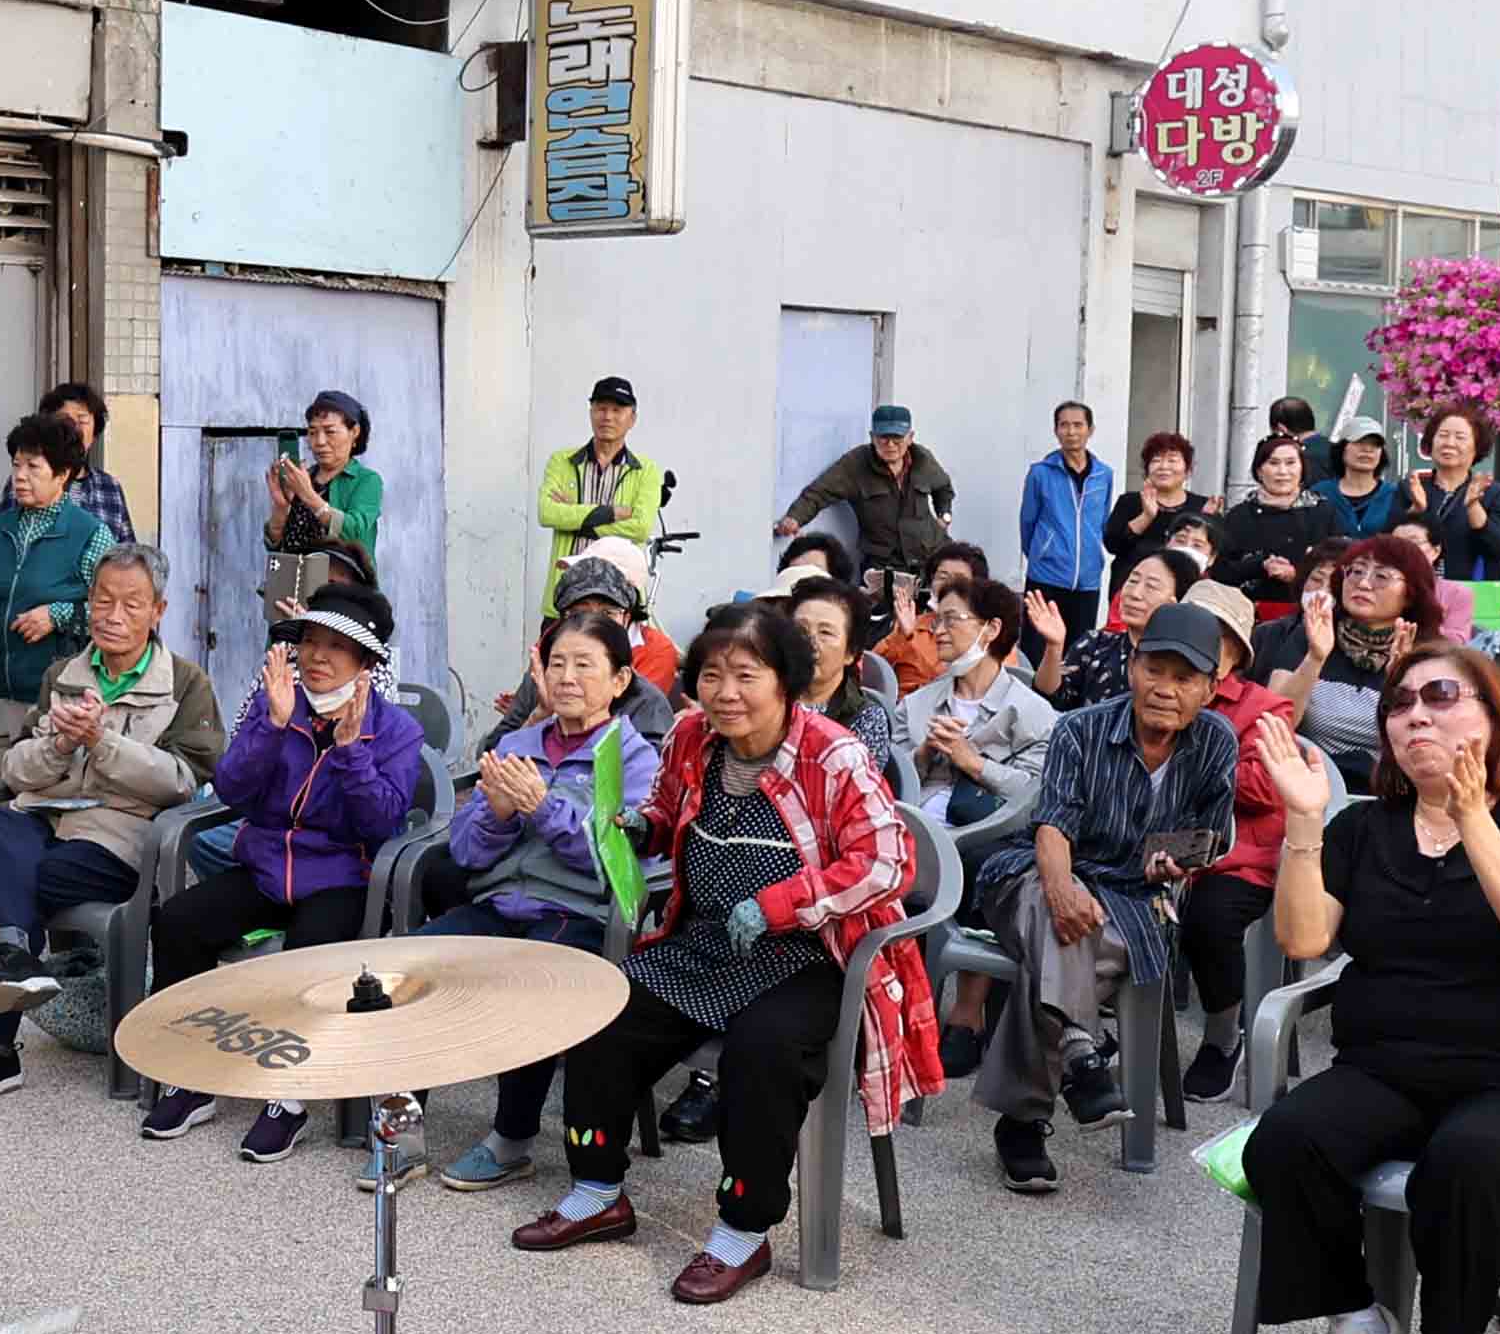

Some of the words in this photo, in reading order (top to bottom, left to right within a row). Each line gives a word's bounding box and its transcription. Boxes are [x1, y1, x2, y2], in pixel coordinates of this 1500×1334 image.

[545, 0, 641, 223] 노래연습장
[1155, 111, 1265, 166] 다방
[1196, 169, 1224, 188] 2F
